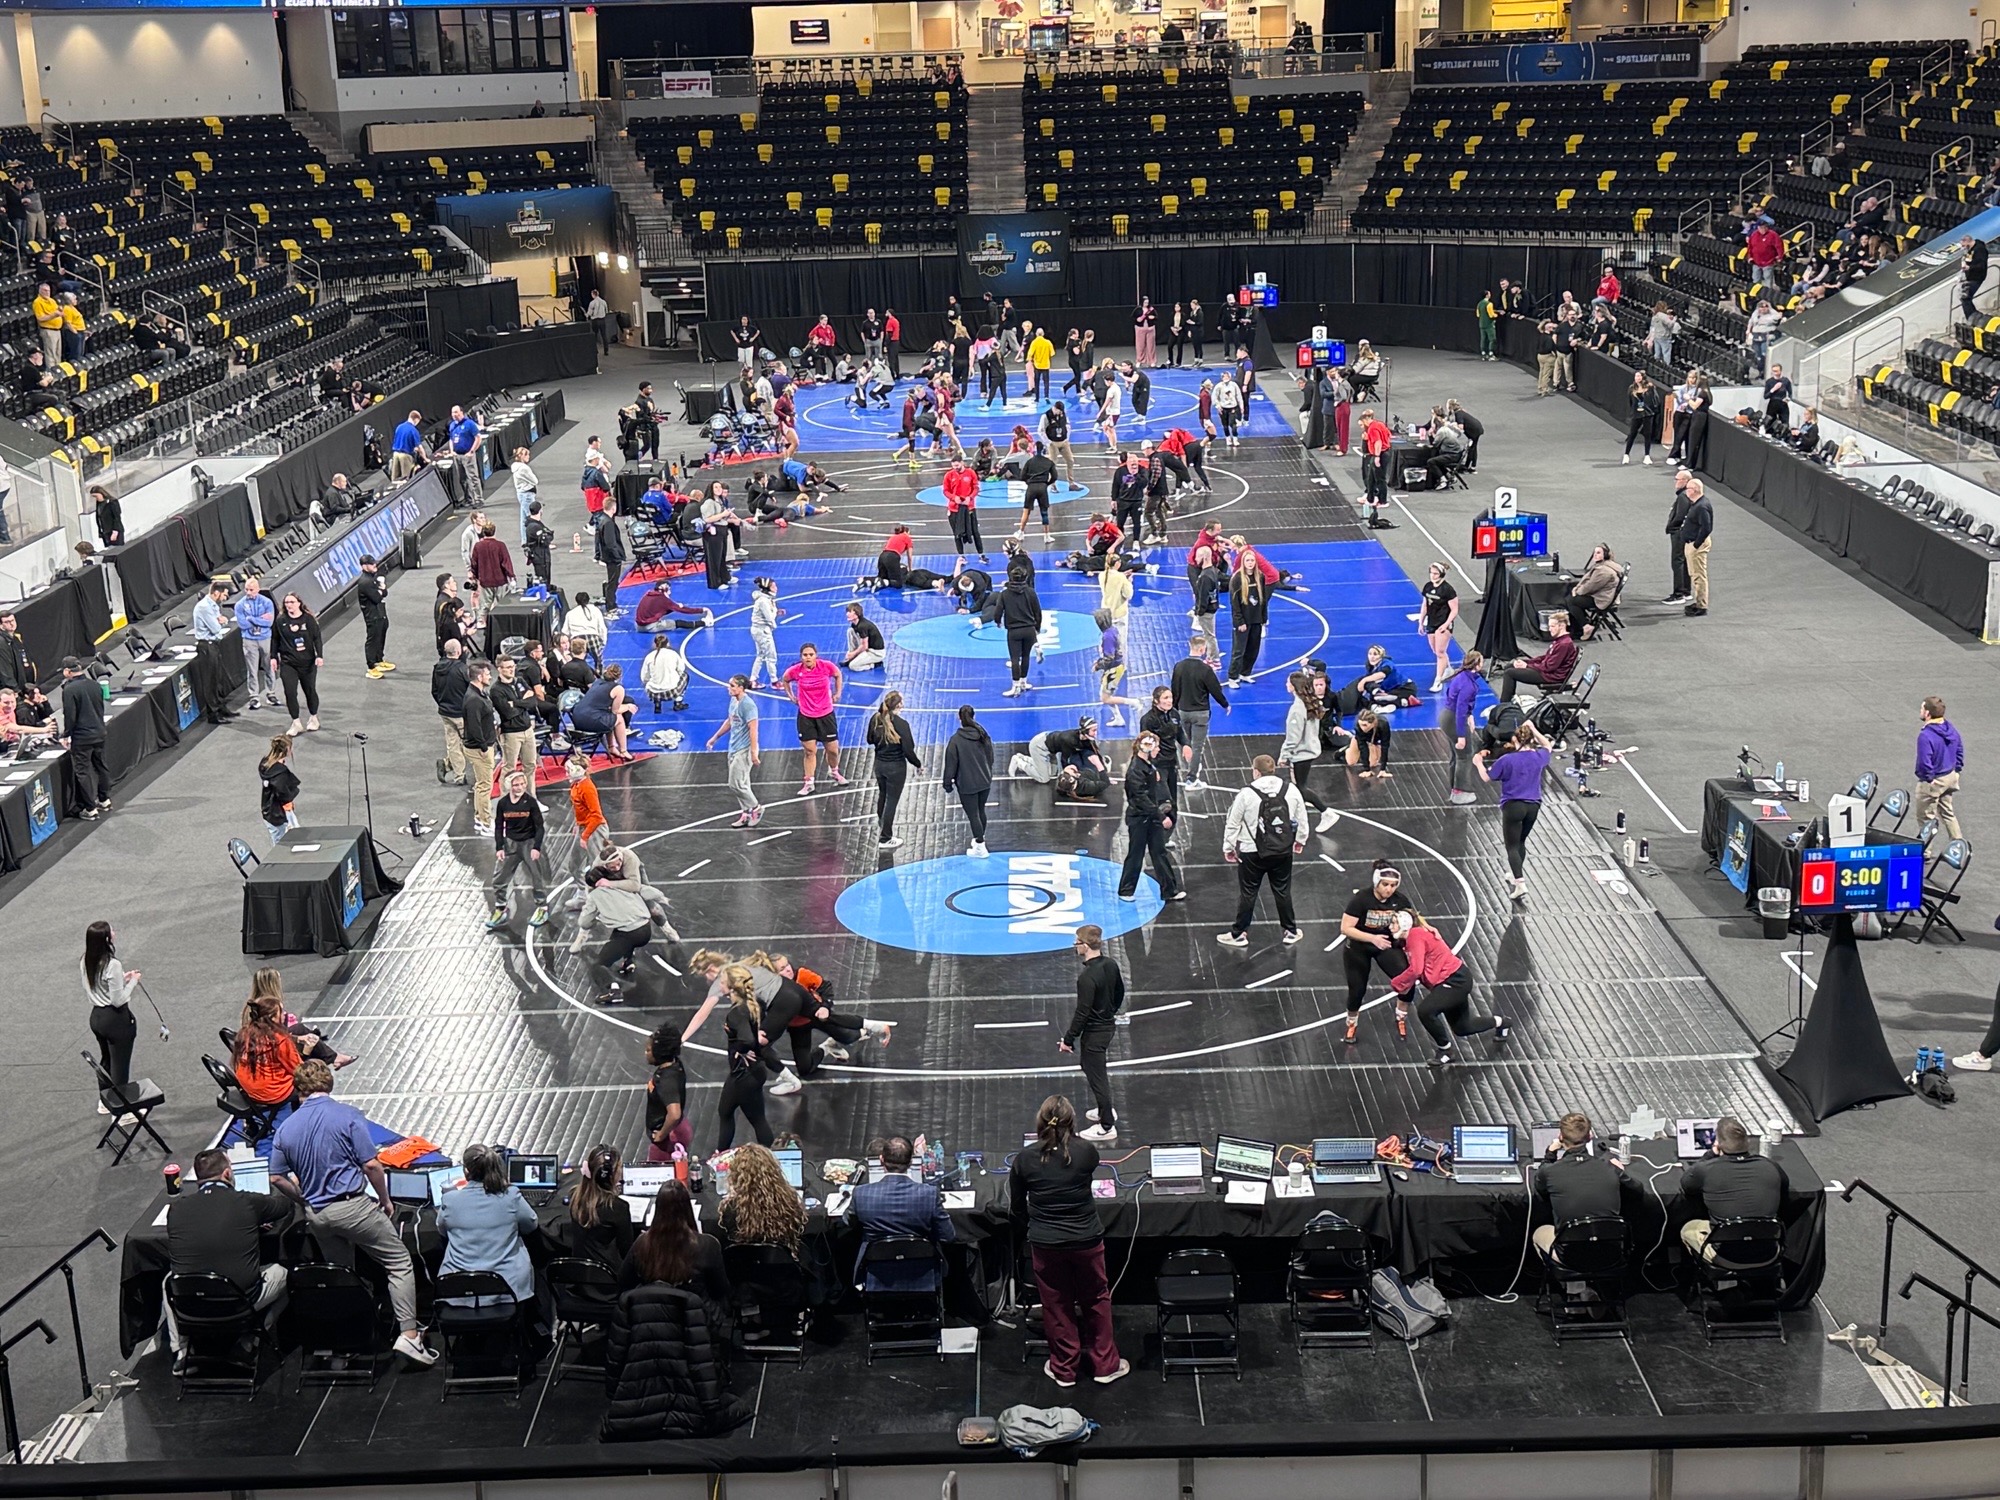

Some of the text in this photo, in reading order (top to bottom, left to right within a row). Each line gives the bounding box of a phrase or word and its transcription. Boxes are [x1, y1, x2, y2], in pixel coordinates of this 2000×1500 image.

[1433, 60, 1470, 69] SPOTLIGHT
[1616, 54, 1658, 63] SPOTLIGHT
[1660, 53, 1690, 62] AWAITS
[665, 78, 710, 91] ESPN
[1257, 274, 1264, 283] 4
[1315, 329, 1324, 340] 3
[1501, 492, 1512, 509] 2
[1482, 533, 1491, 547] 0
[1499, 529, 1524, 542] 0:00
[1532, 531, 1541, 544] 0
[313, 496, 421, 593] THE SPOTLIGHT AWAITS
[1840, 806, 1853, 833] 1
[1850, 849, 1876, 859] MAT 1
[1841, 867, 1882, 887] 3:00
[1899, 870, 1909, 890] 1
[1812, 874, 1825, 895] 0
[1007, 853, 1085, 935] NCAA
[1845, 889, 1869, 897] PERIOD
